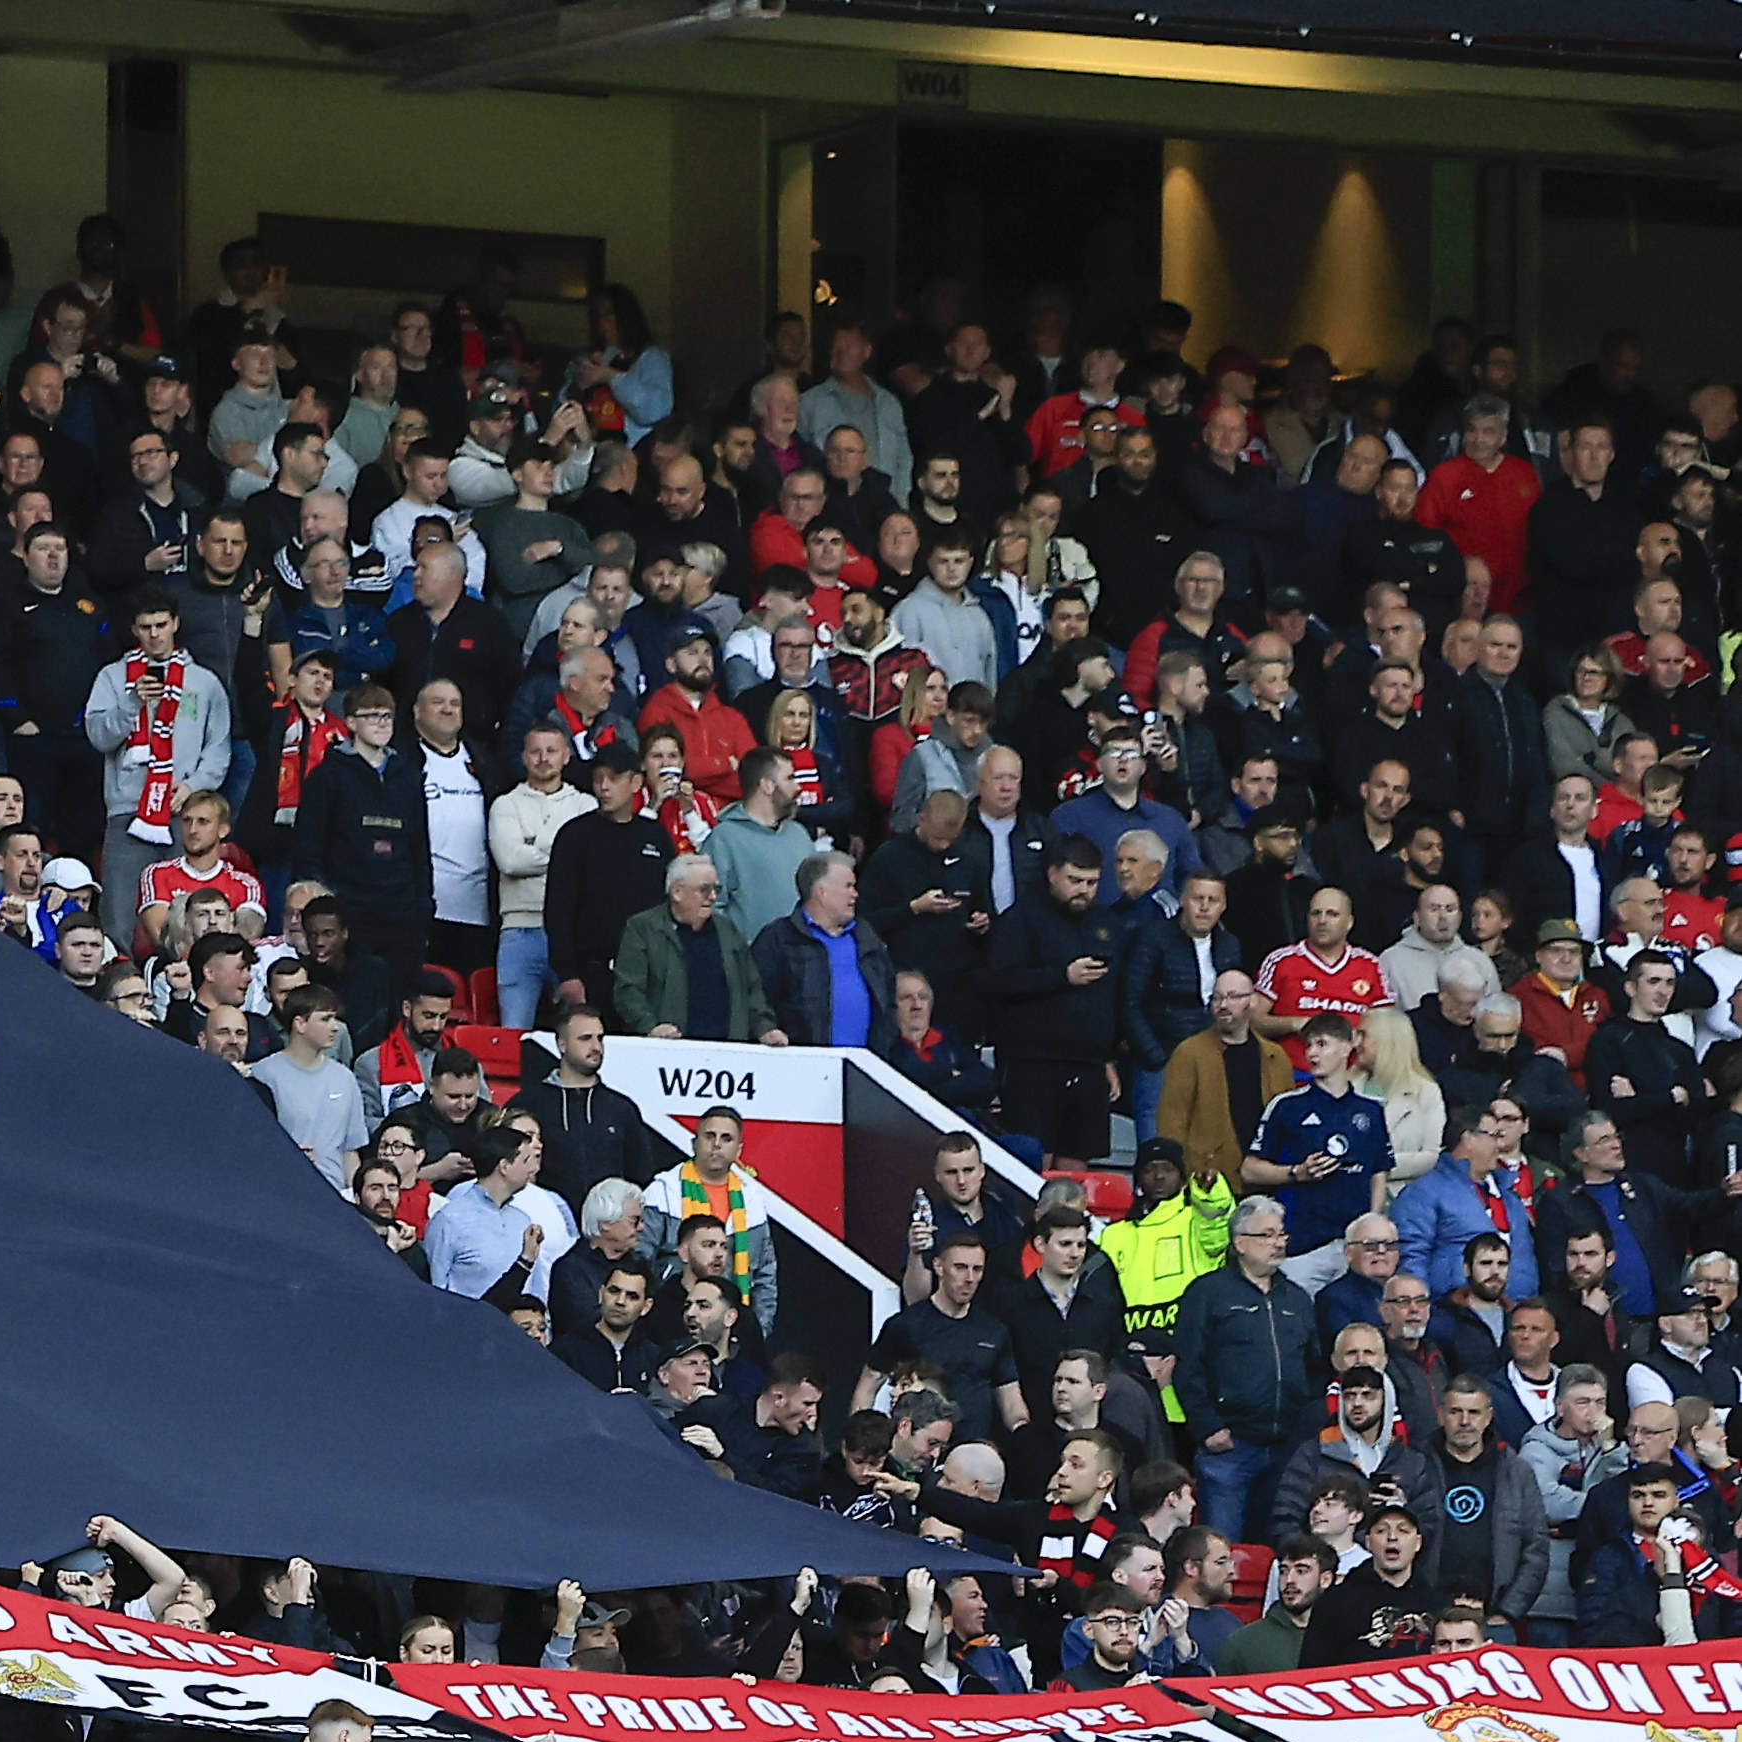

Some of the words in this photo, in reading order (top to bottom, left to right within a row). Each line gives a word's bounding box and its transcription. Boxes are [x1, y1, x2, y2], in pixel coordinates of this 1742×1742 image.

[657, 1066, 756, 1102] W204
[49, 1611, 277, 1670] ARMY
[1212, 1649, 1532, 1715] NOTHING
[1547, 1655, 1664, 1716] ON
[448, 1684, 558, 1727] THE
[567, 1692, 740, 1735] PRIDE
[749, 1698, 818, 1738] OF
[826, 1708, 935, 1740] ALL
